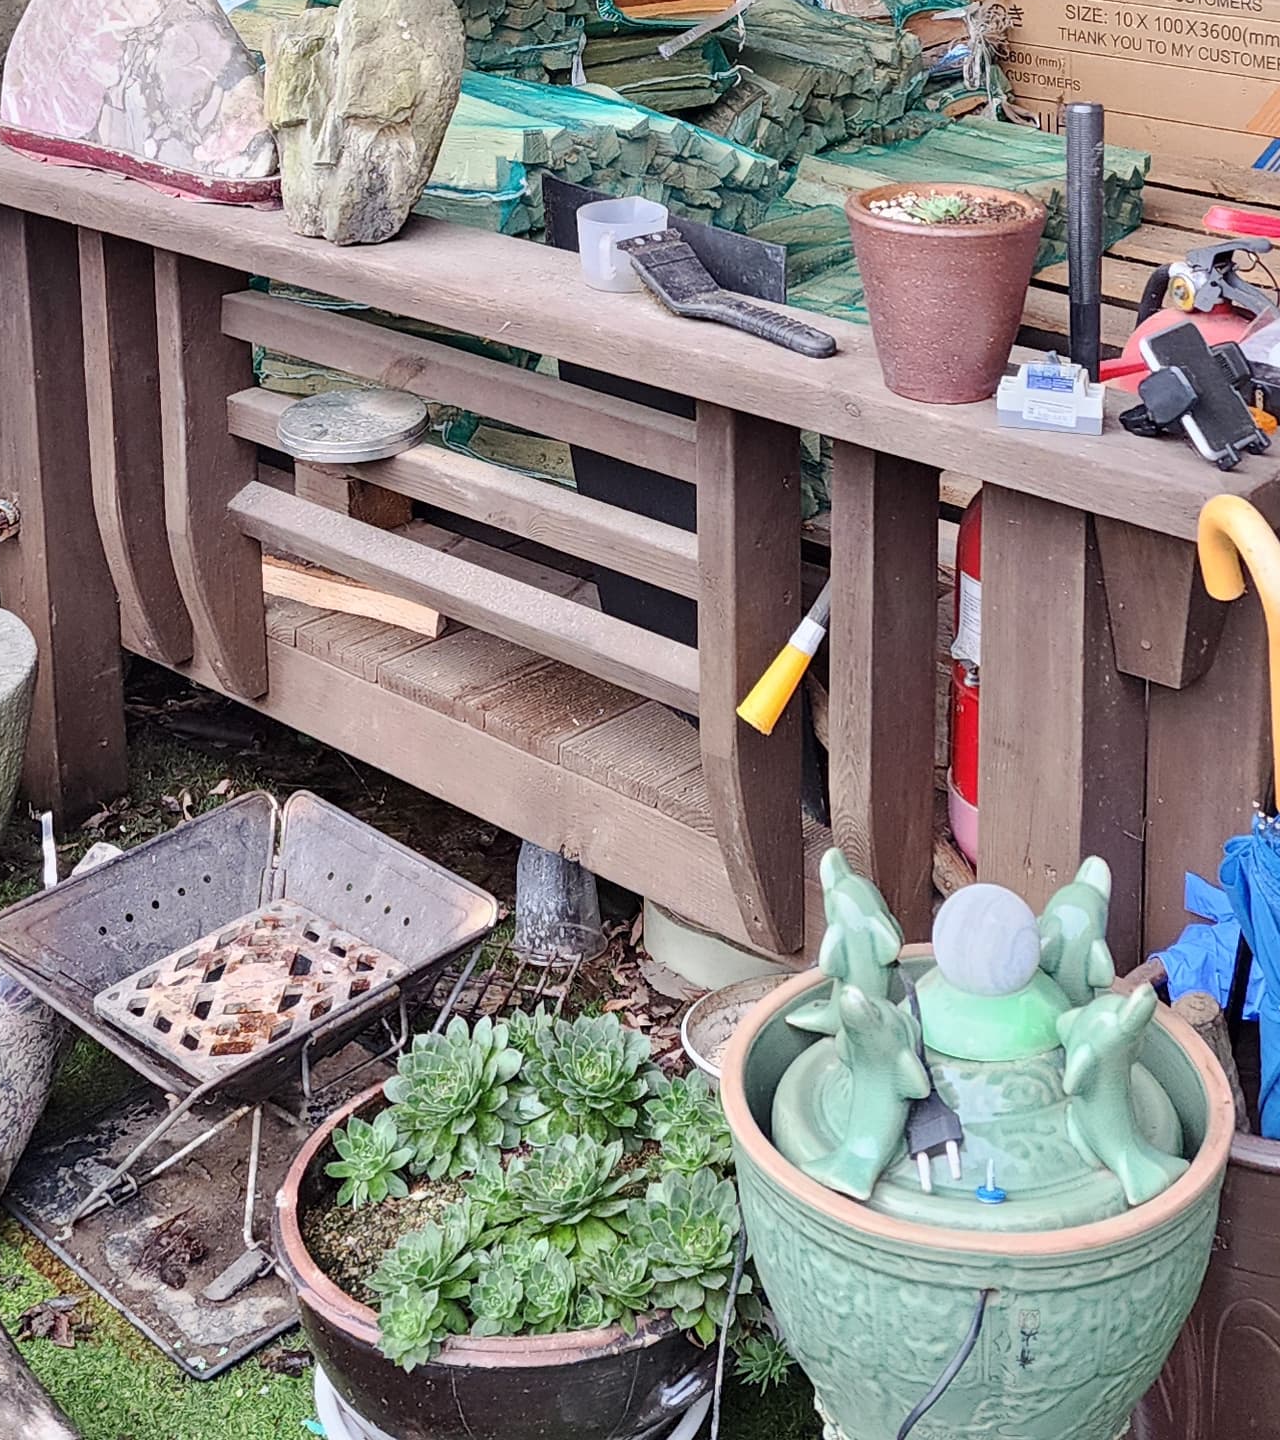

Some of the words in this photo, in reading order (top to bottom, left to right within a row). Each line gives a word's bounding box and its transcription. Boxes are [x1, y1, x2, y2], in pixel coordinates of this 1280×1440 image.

[1065, 4, 1109, 25] SIZE:
[1058, 27, 1108, 47] THANK
[1110, 34, 1142, 51] YOU
[1146, 39, 1168, 55] TO
[1172, 43, 1195, 59] MY
[1006, 69, 1081, 92] CUSTOMERS
